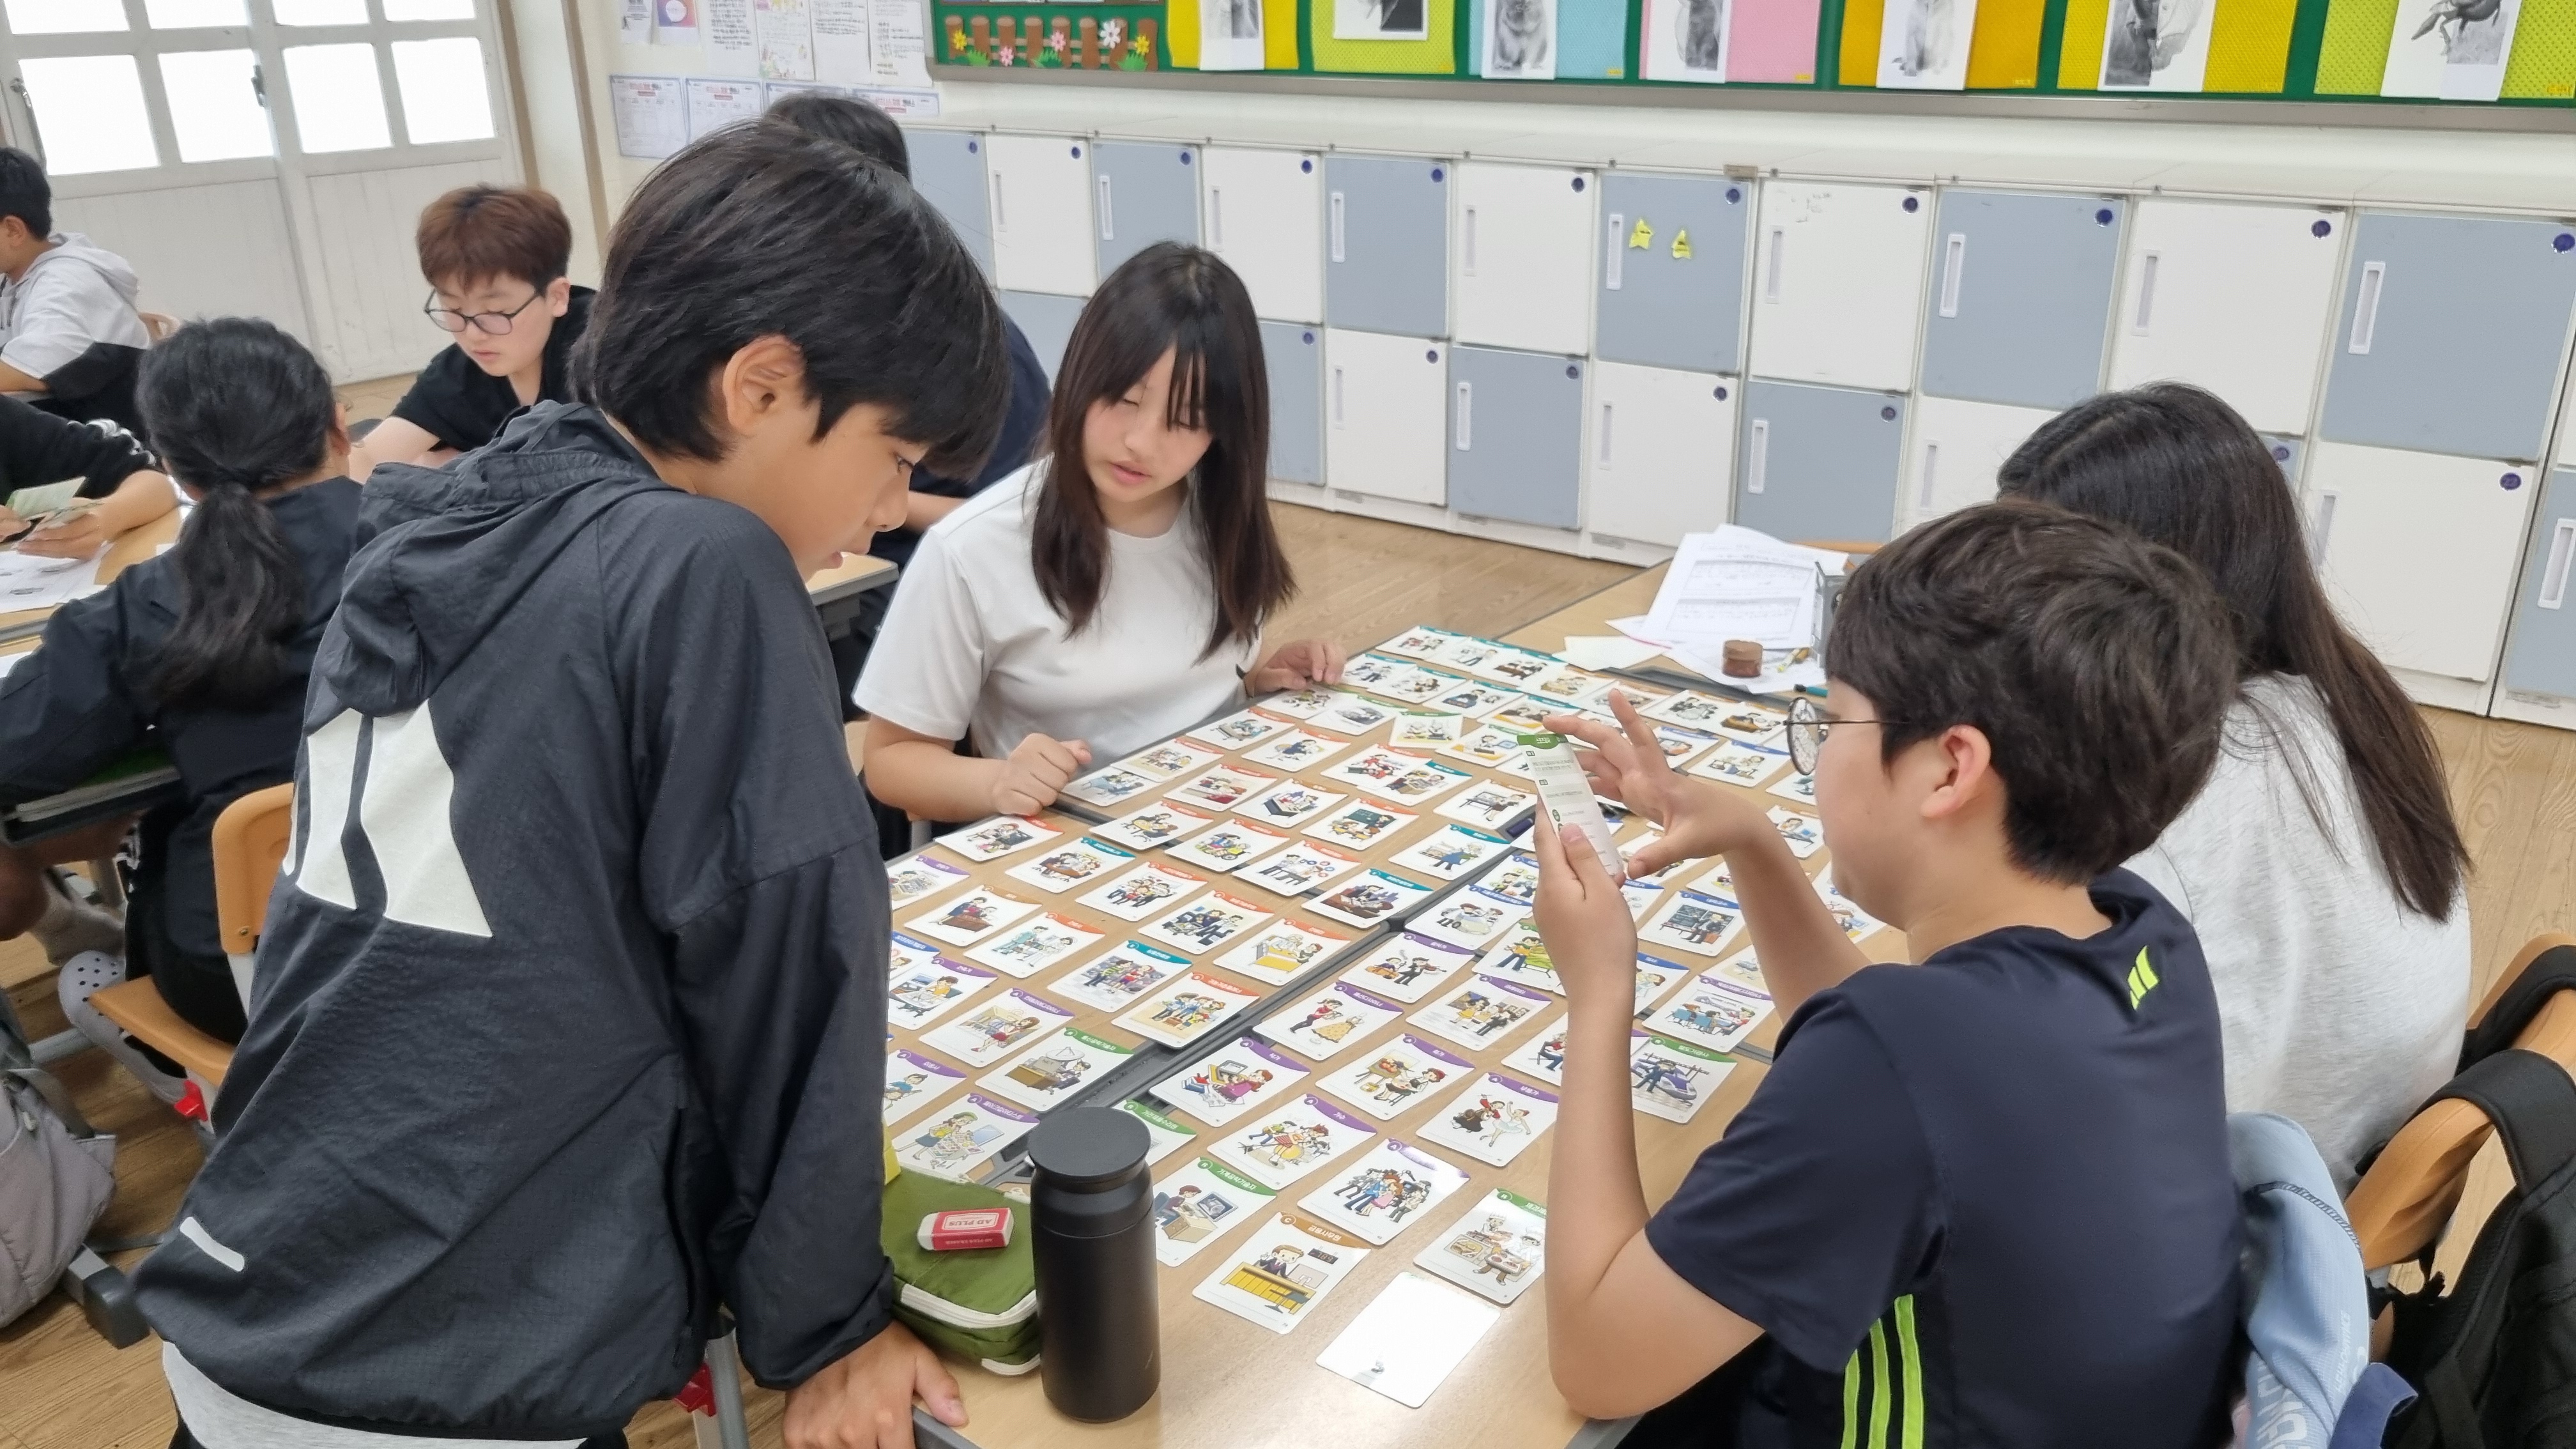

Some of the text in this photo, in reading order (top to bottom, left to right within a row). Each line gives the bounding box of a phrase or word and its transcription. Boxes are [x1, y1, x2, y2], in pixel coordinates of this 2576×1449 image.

[1023, 995, 1061, 1014] 인테리어디자이너
[1269, 1052, 1281, 1061] 작가
[1520, 1085, 1539, 1096] 무용가
[983, 1101, 1023, 1120] 메이크업아티스트
[1333, 1112, 1346, 1120] 가수
[1217, 1168, 1257, 1191] 기계공학기술자
[1308, 1225, 1342, 1241] 금융사무원
[1317, 1251, 1333, 1262] 789
